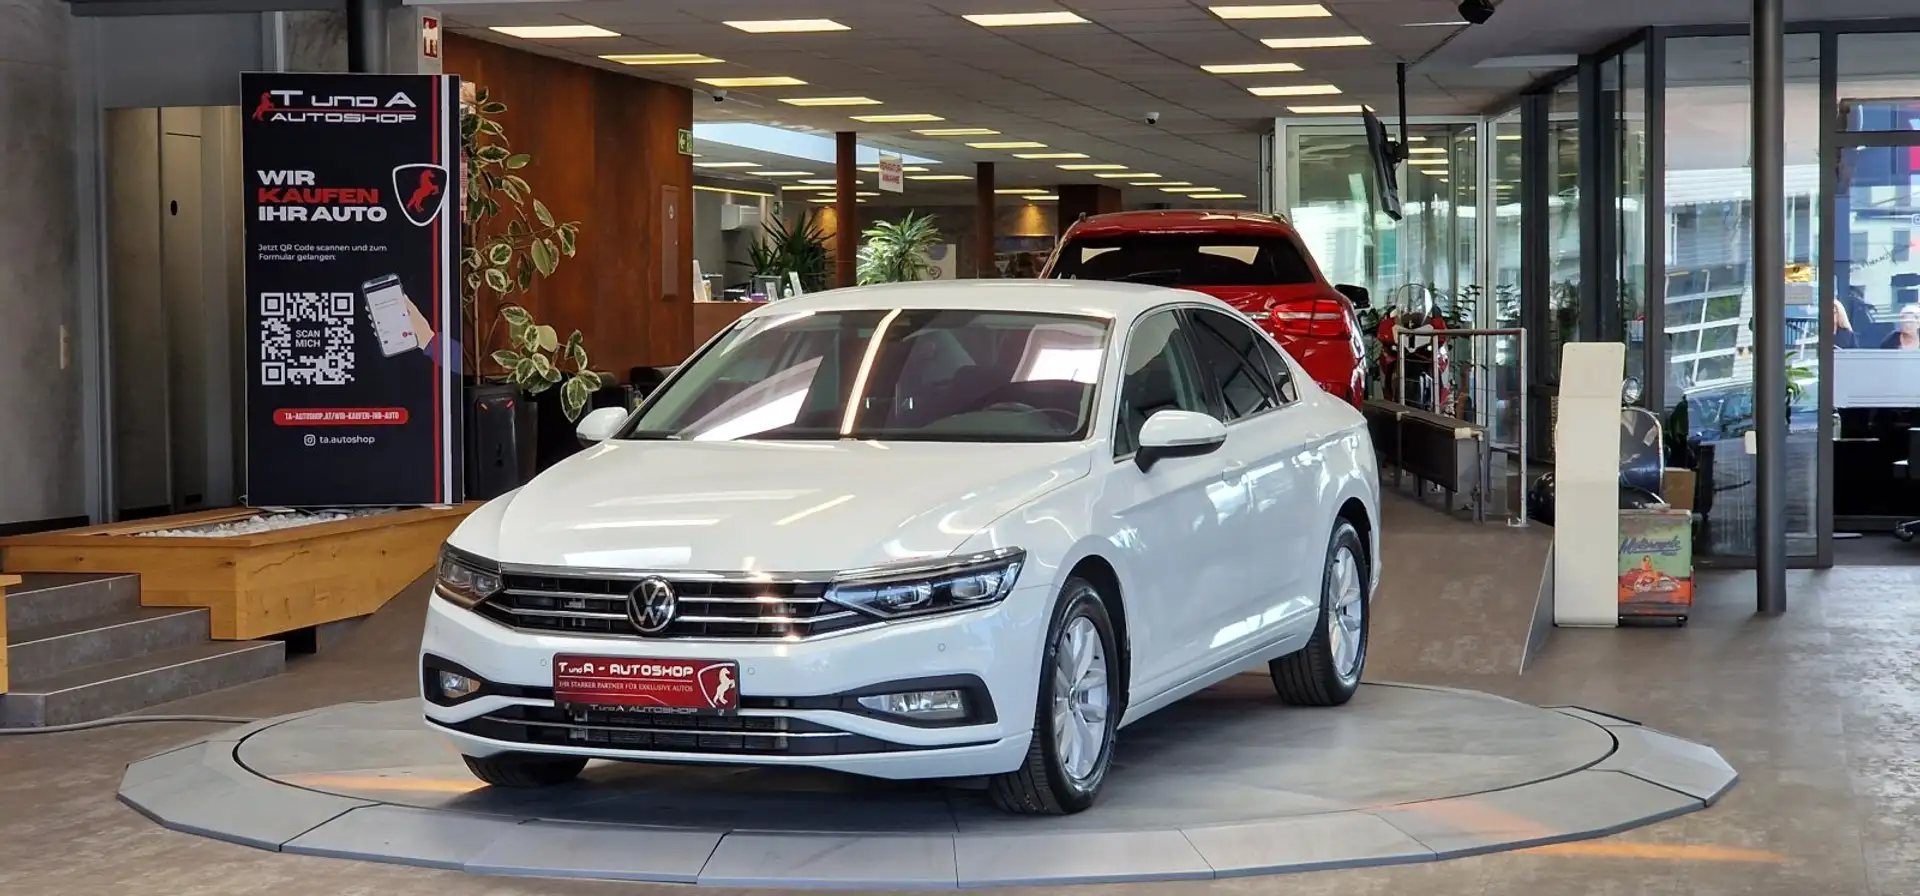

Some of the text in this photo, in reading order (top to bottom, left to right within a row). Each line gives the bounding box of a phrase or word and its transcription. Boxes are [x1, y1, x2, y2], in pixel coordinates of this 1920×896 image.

[270, 90, 303, 106] T
[384, 91, 416, 108] A
[271, 113, 416, 123] AUTOSHOP
[257, 170, 315, 185] WIR
[258, 188, 379, 203] KAUFEN
[258, 206, 387, 222] IHR AUTO
[258, 243, 277, 251] Jetzt
[279, 243, 292, 252] QR
[351, 243, 368, 251] und
[258, 253, 336, 262] Formular gelangen:
[295, 330, 321, 338] SCAN
[295, 340, 321, 348] MICH
[319, 435, 375, 444] ta.autoshop
[558, 662, 568, 674] T
[583, 662, 594, 674] A
[609, 663, 694, 678] AUTOSHOP
[570, 681, 597, 689] STARKER
[598, 682, 624, 690] PARTNER
[625, 682, 637, 691] FÜR
[638, 683, 671, 692] EXKLUSIVE
[672, 684, 694, 693] AUTOS
[629, 704, 699, 714] AUTOSHOP
